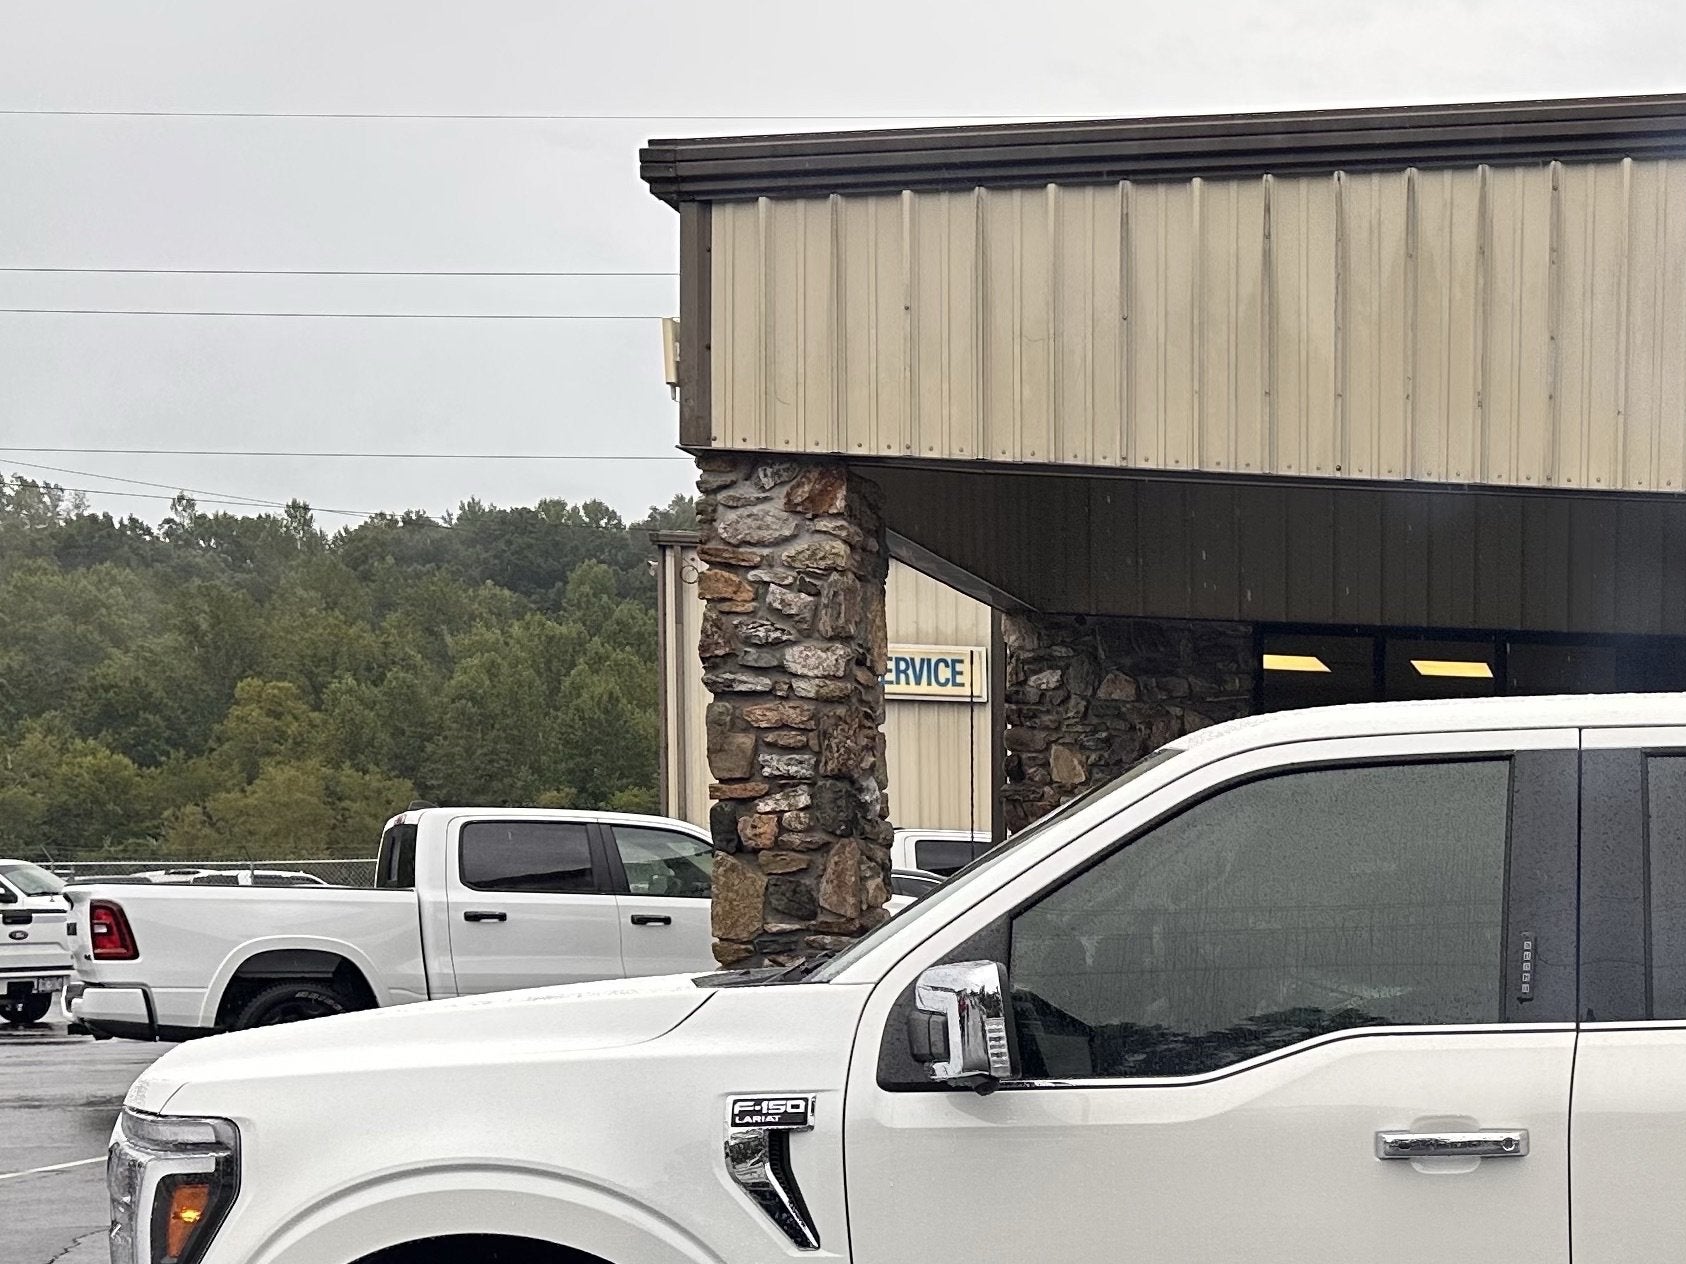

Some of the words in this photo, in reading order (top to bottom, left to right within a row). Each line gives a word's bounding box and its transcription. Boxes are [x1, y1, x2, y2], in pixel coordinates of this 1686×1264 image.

[880, 656, 965, 687] ERVICE
[733, 1100, 806, 1114] F-150
[735, 1115, 781, 1123] LARIAT
